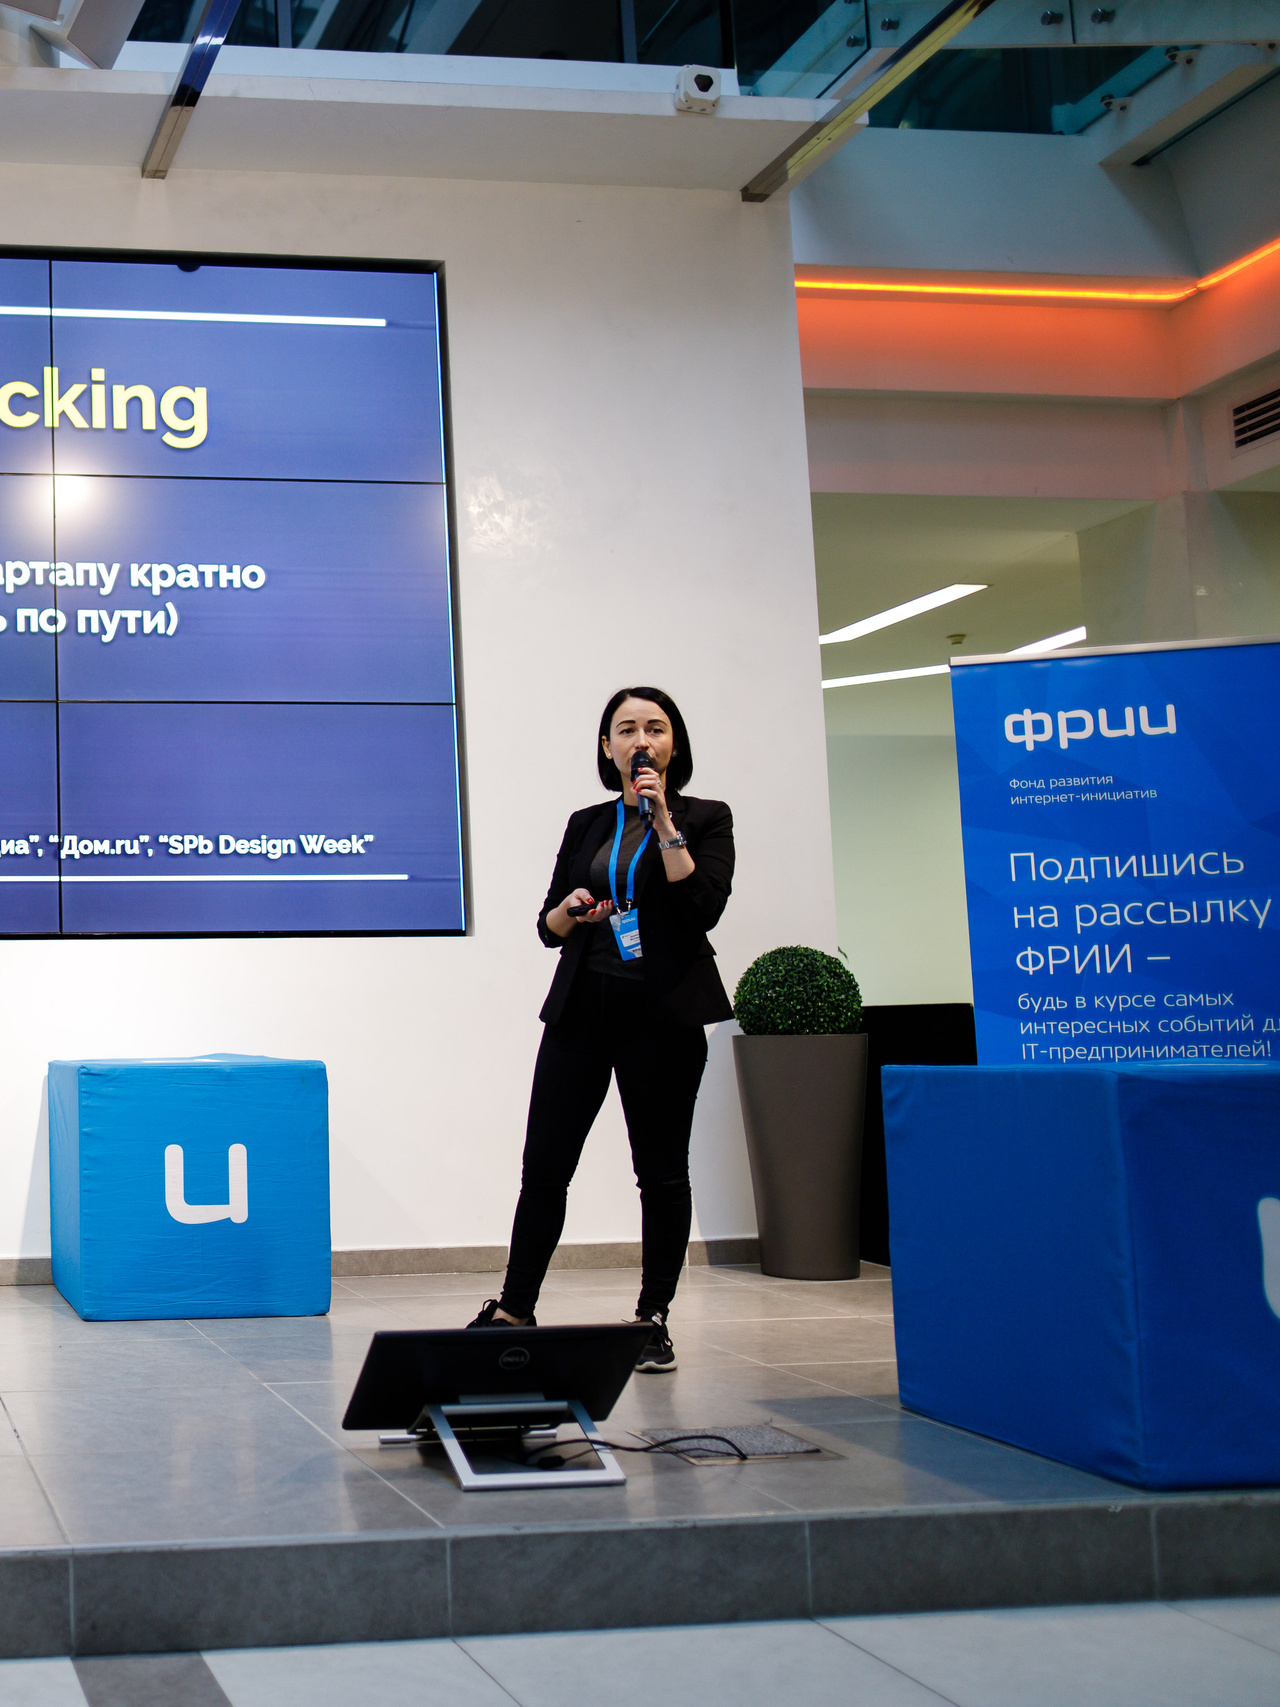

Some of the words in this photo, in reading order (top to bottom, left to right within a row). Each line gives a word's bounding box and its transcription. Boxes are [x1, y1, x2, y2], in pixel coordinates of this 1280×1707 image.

[131, 564, 266, 590] кратно
[17, 608, 66, 633] по
[78, 602, 178, 642] пути)
[1010, 779, 1045, 788] Фонд
[1050, 776, 1113, 789] развития
[1011, 790, 1157, 805] интернет-инициатив
[219, 835, 296, 859] Design
[1010, 852, 1244, 883] Подпишись
[1014, 906, 1058, 928] на
[1076, 899, 1271, 934] рассылку
[1017, 944, 1131, 975] ФРИИ
[1019, 993, 1067, 1013] будь
[1076, 997, 1086, 1008] в
[1095, 995, 1155, 1011] курсе
[1164, 994, 1234, 1006] самых
[1021, 1021, 1150, 1037] интересных
[1159, 1015, 1254, 1032] событий
[1023, 1041, 1270, 1063] IT-предпринимателей!
